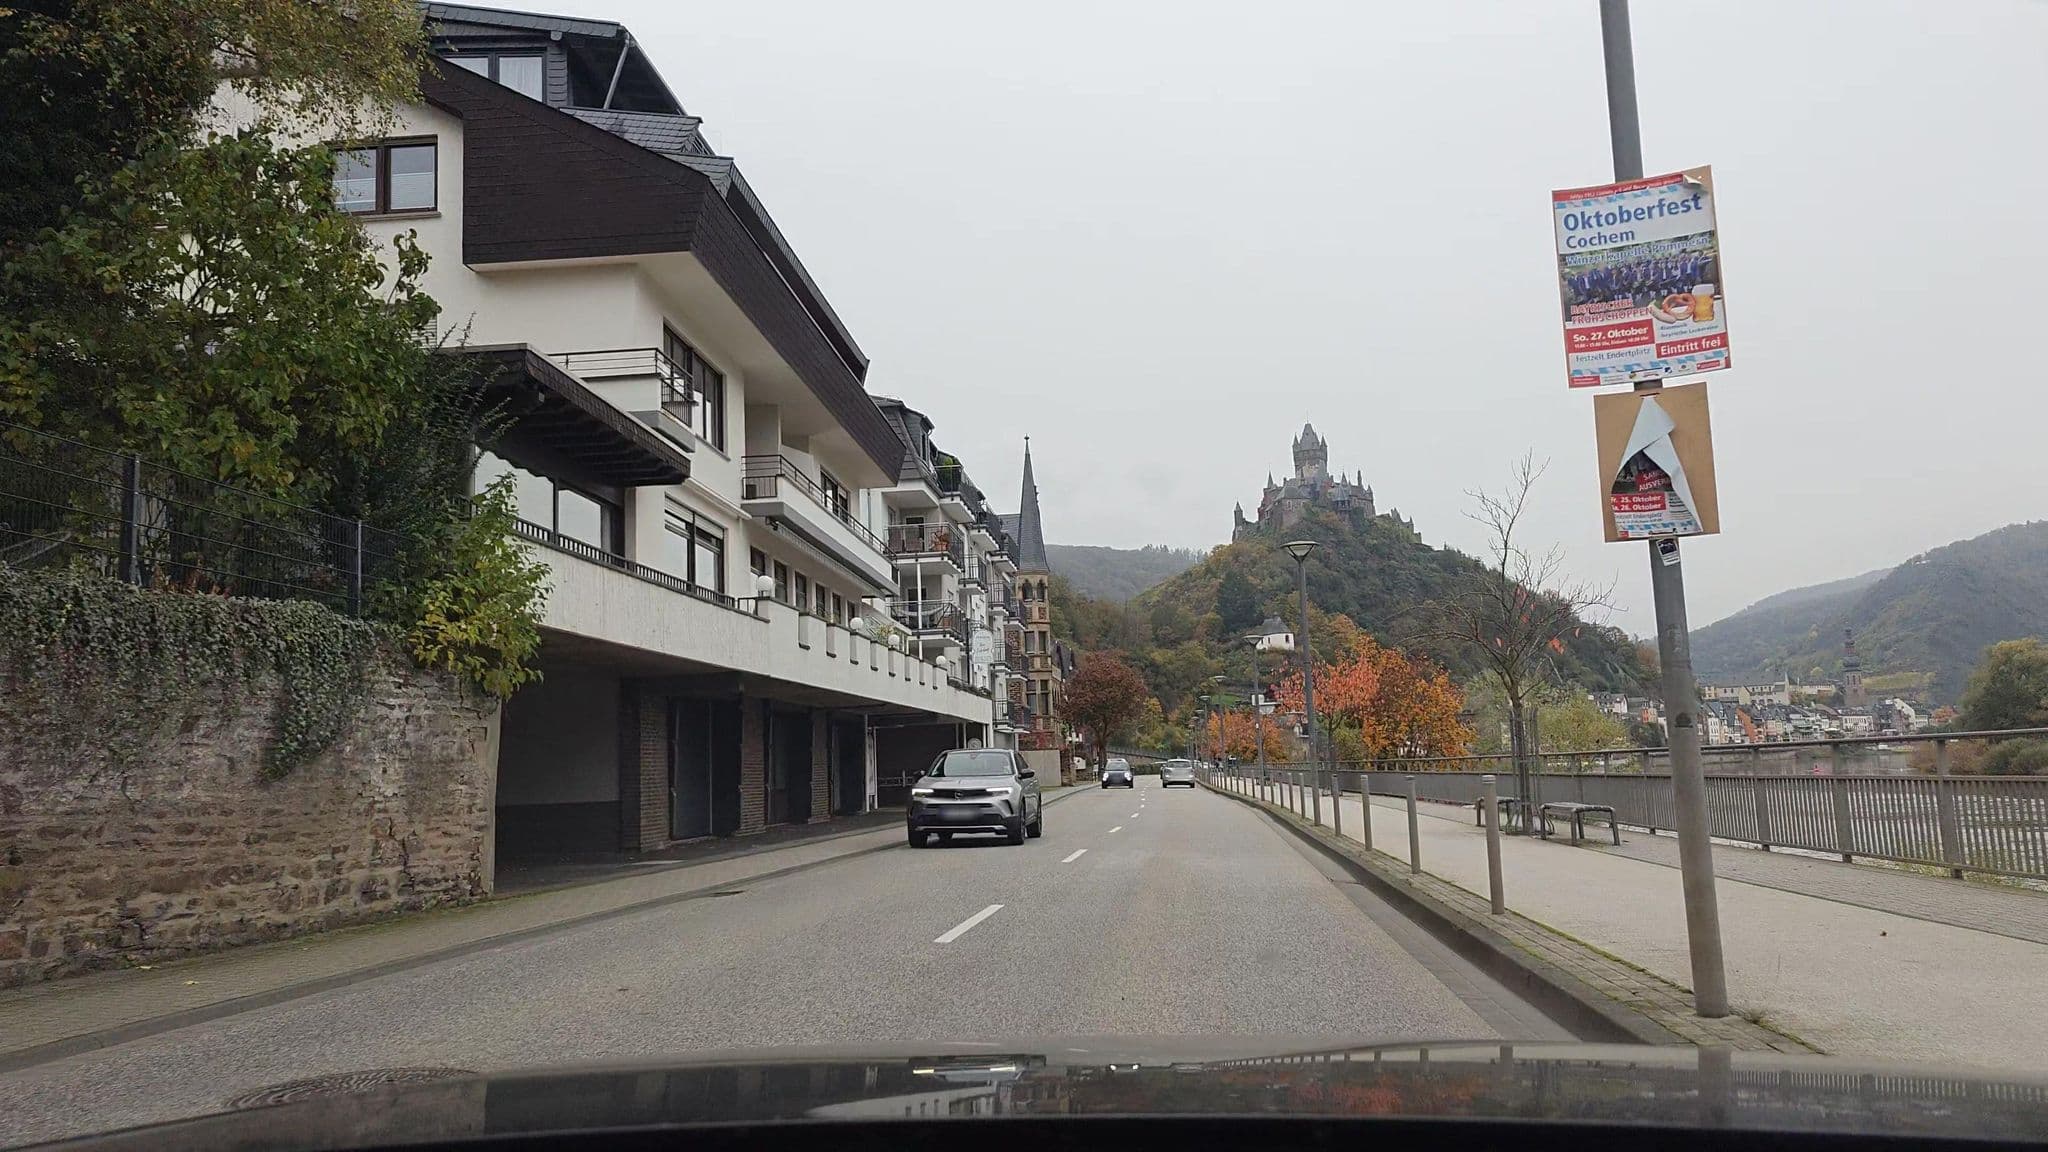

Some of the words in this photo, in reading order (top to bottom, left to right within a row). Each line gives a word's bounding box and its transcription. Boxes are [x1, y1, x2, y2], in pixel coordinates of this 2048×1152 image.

[1563, 193, 1703, 231] Oktoberfest
[1566, 228, 1635, 249] Cochem
[1573, 333, 1588, 343] So.
[1590, 331, 1606, 341] 27.
[1607, 326, 1649, 339] Oktober
[1660, 341, 1699, 356] Eintritt
[1701, 336, 1721, 349] frei
[1575, 353, 1604, 362] Festzelt
[1606, 348, 1651, 360] Endertplatz
[1632, 495, 1662, 503] Oktober
[1632, 503, 1662, 511] Oktober
